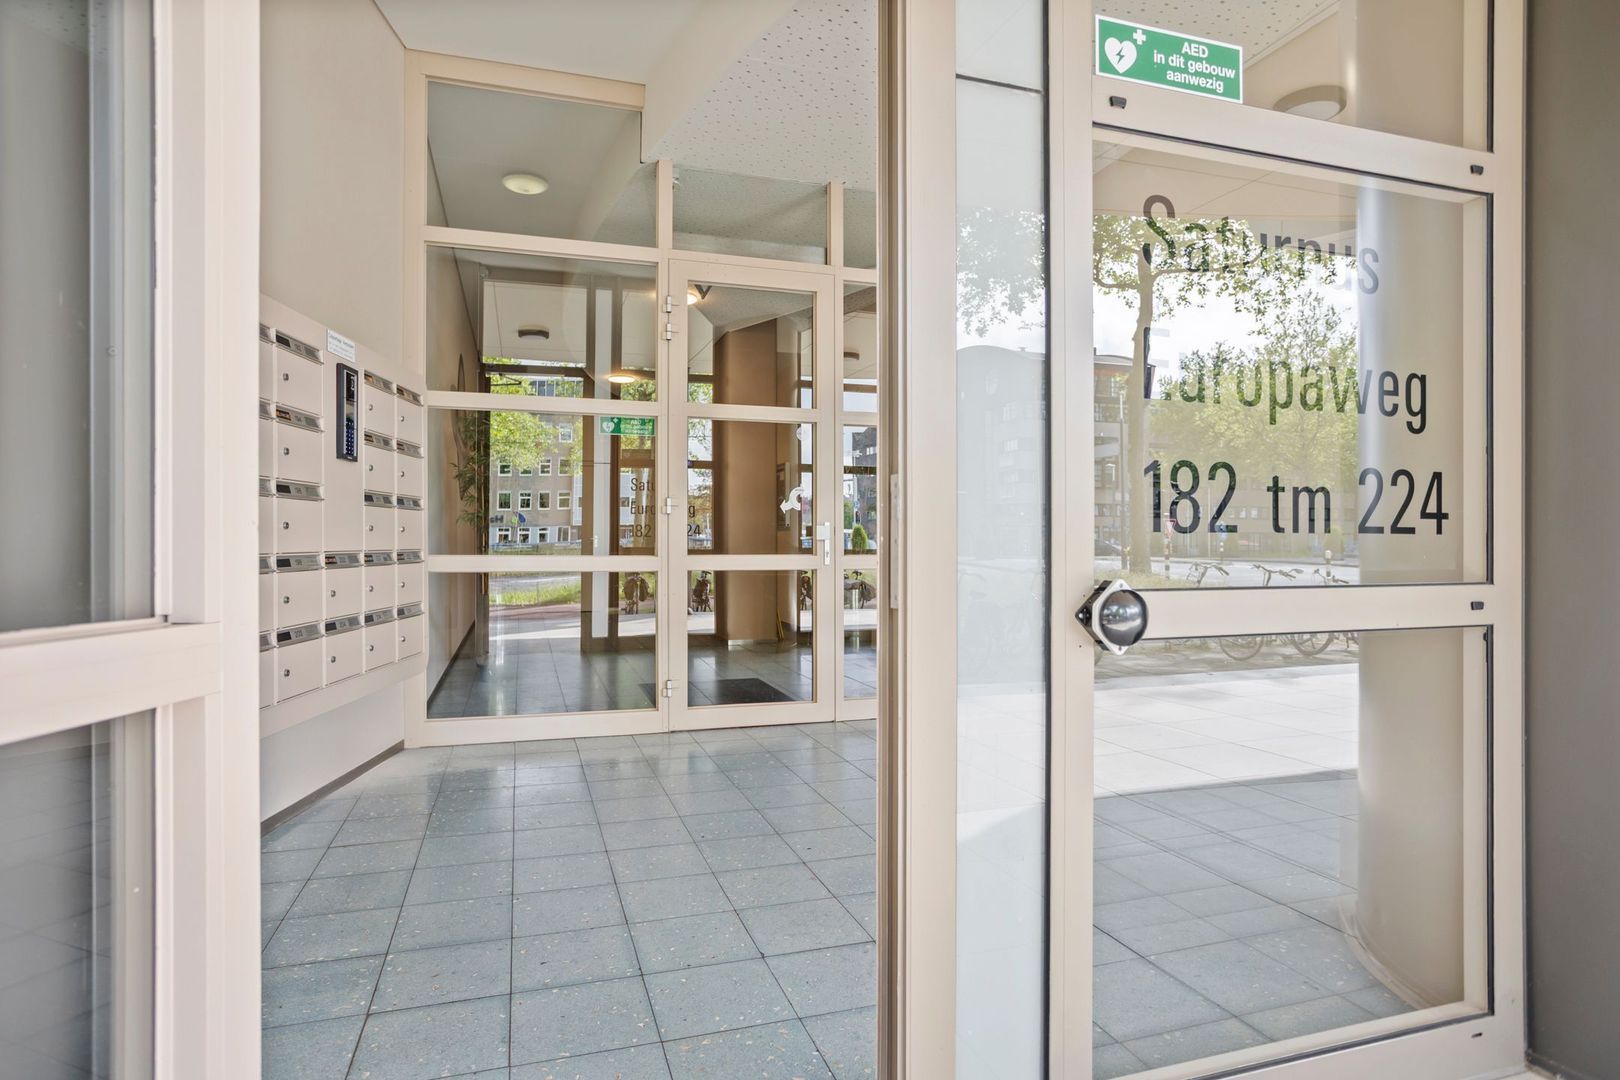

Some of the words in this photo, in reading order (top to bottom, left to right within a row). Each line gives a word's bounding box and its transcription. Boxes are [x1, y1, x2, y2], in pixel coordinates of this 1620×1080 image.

[1153, 49, 1165, 65] in
[1168, 52, 1185, 69] dit
[1187, 59, 1236, 79] gebouw
[1181, 42, 1209, 58] AED
[1166, 69, 1224, 93] aanwezig
[1142, 194, 1380, 294] Saturnus
[1143, 459, 1238, 535] 182
[1266, 474, 1331, 535] tm
[1357, 467, 1450, 536] 224
